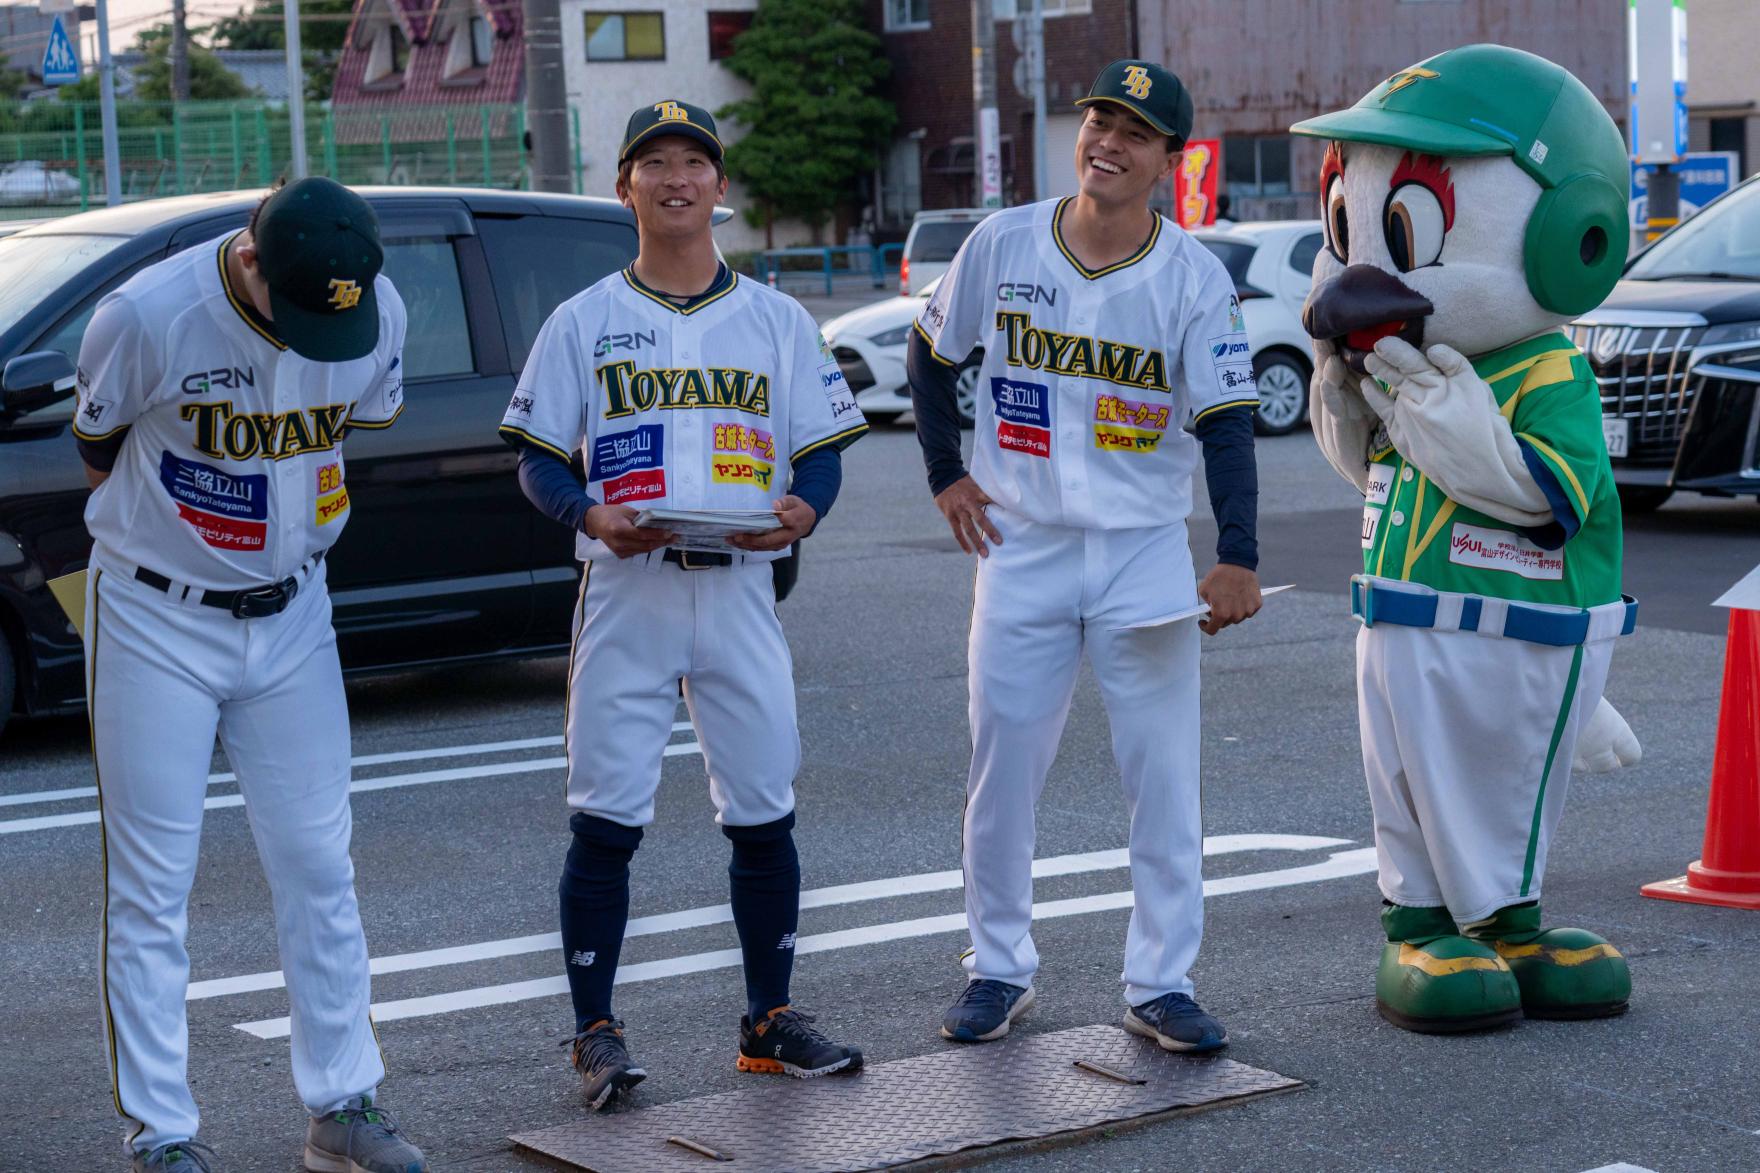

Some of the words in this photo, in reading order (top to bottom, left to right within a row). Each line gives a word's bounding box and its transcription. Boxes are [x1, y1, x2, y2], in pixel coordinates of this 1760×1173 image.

[1121, 65, 1152, 100] TB
[997, 282, 1057, 307] GRN
[593, 329, 657, 358] GRN
[995, 310, 1172, 393] TOYAMA
[181, 366, 255, 395] GRN
[595, 359, 771, 420] TOYAMA
[715, 423, 776, 461] 古城モタース
[175, 463, 252, 502] 三協立山
[1452, 533, 1482, 556] USUI
